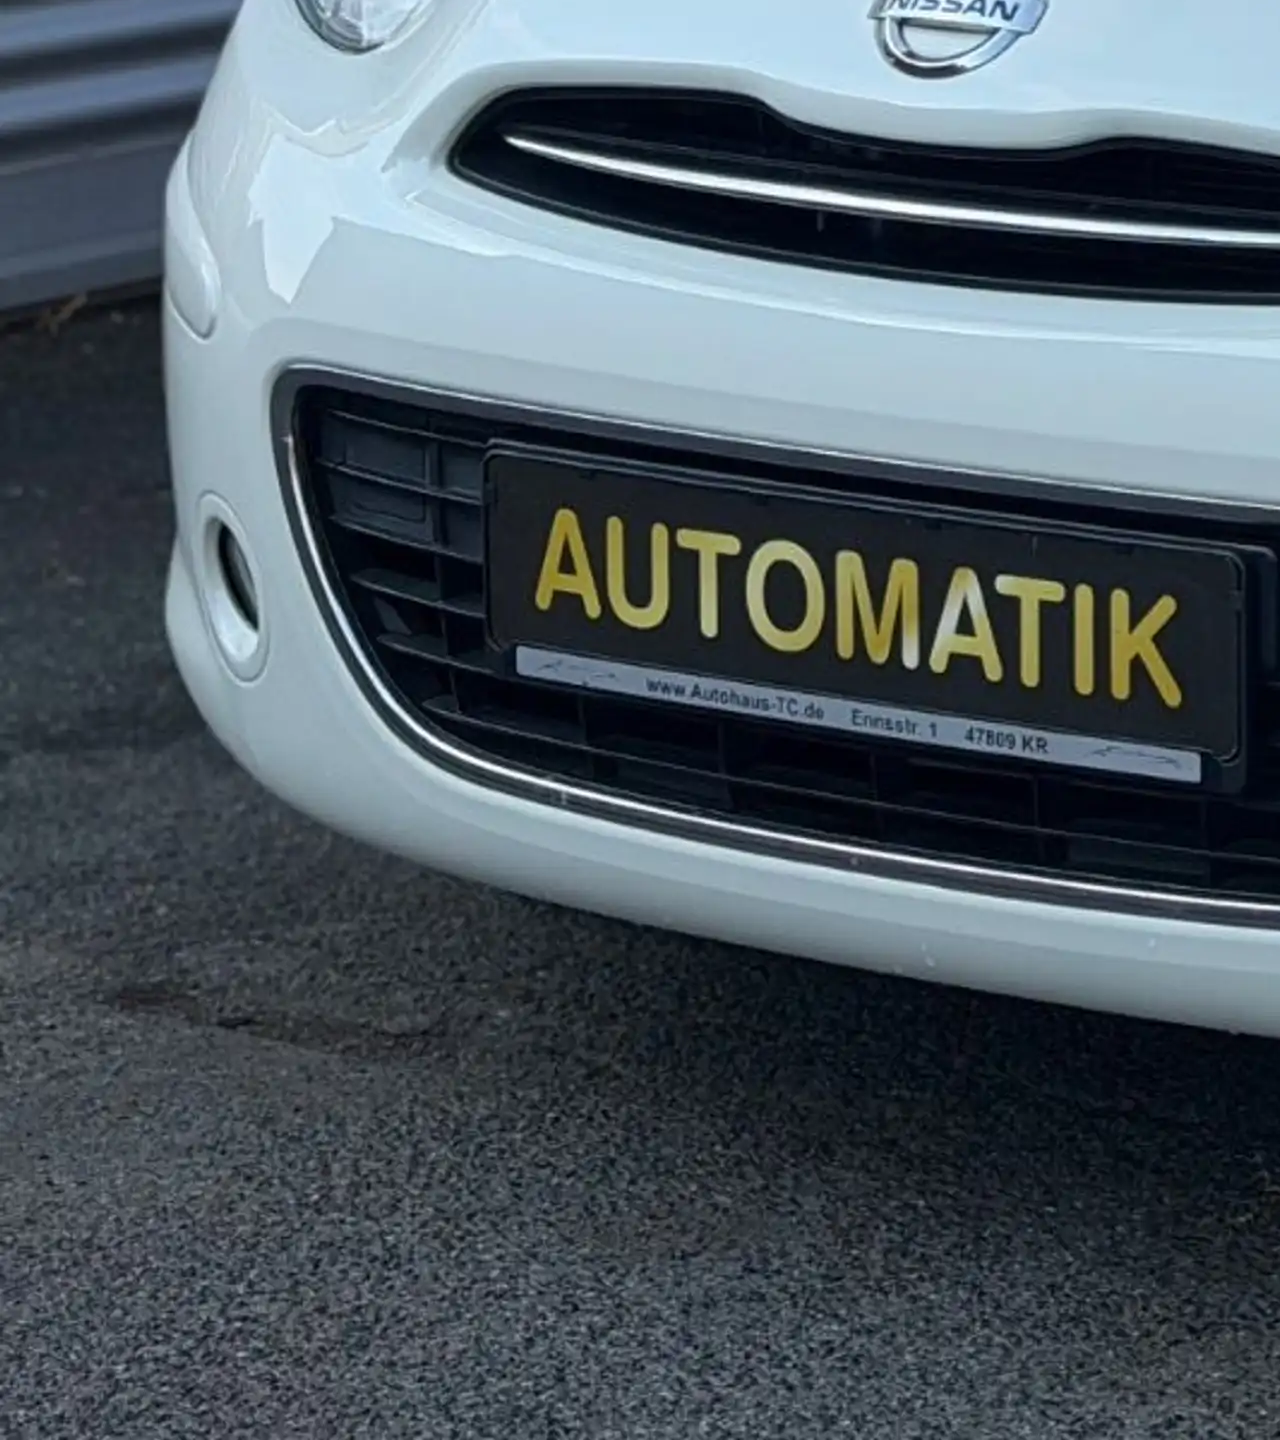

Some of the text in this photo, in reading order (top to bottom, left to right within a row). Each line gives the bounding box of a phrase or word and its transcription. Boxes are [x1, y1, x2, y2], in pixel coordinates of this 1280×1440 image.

[534, 507, 1182, 708] AUTOMATIK
[646, 676, 825, 721] www.Autohaus-TC.de
[928, 721, 938, 738] 1
[964, 725, 1016, 751] 47809
[1021, 734, 1048, 754] KR
